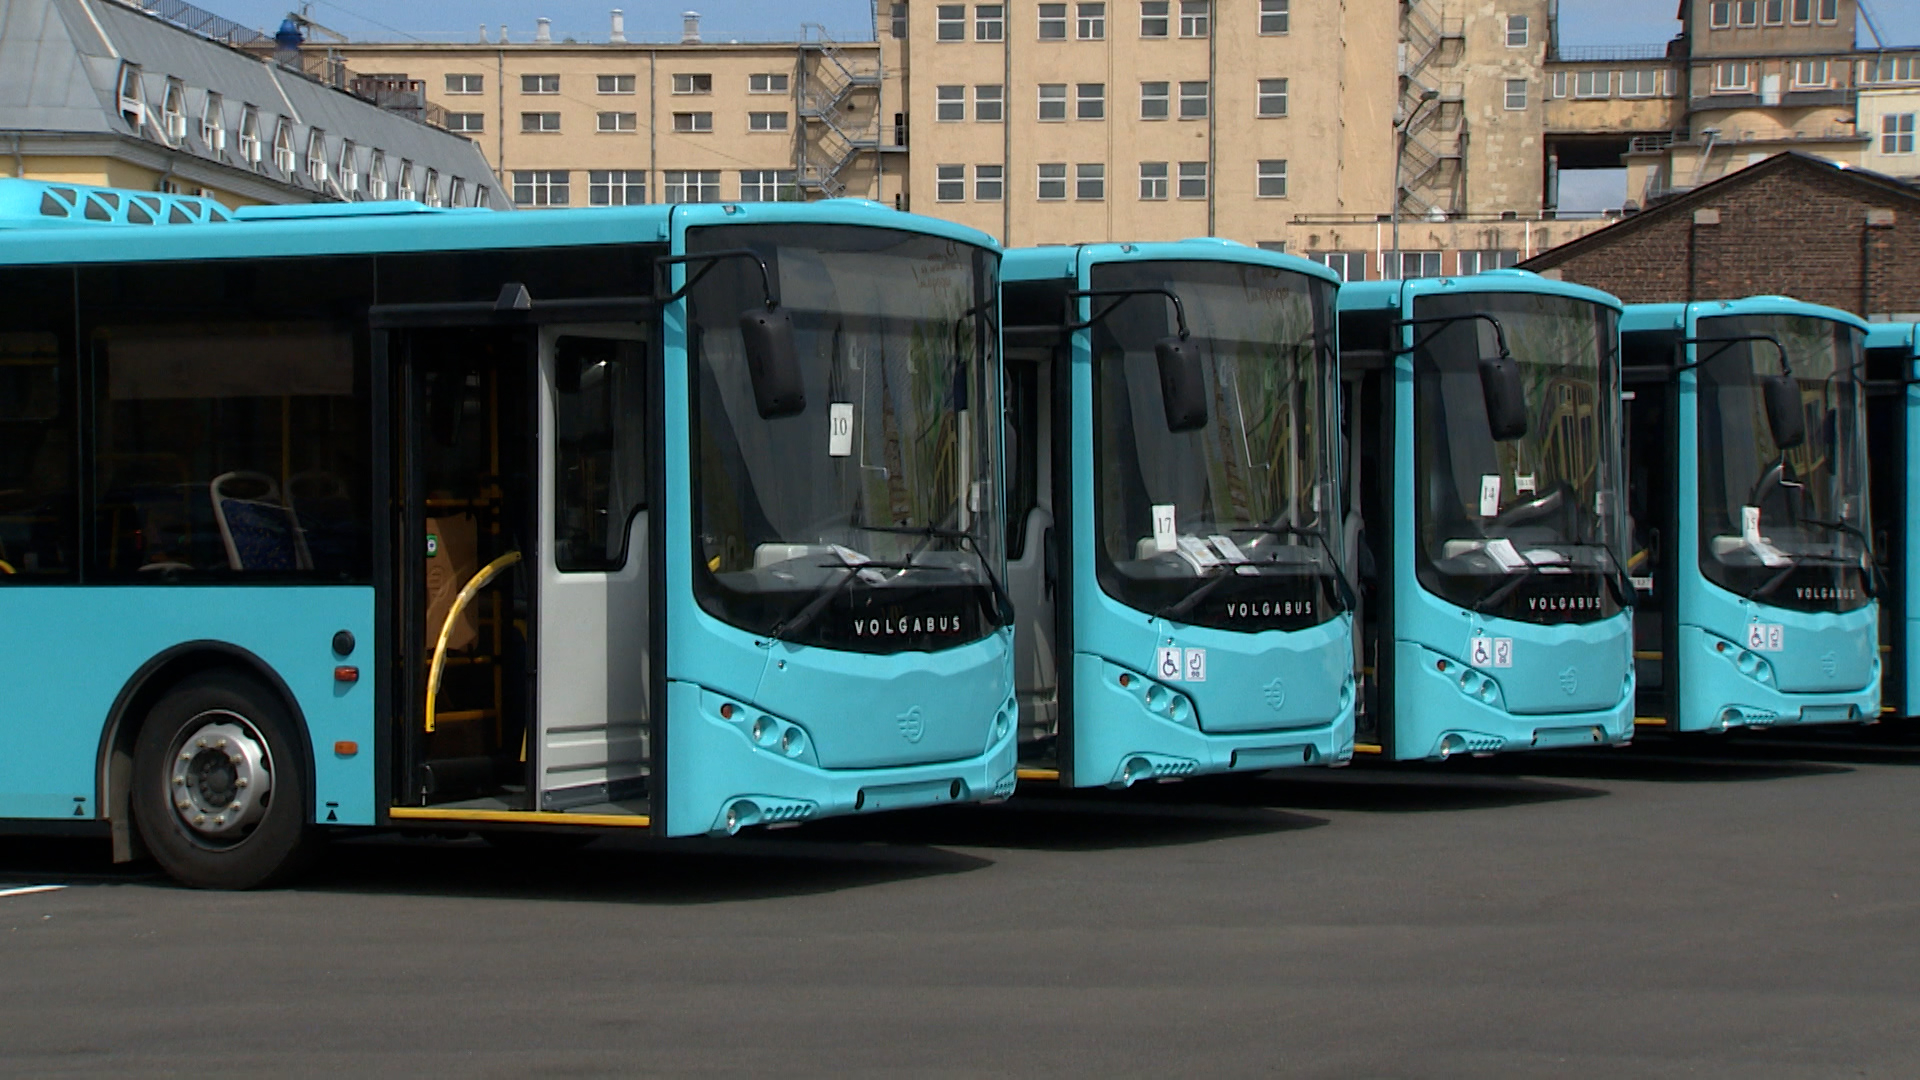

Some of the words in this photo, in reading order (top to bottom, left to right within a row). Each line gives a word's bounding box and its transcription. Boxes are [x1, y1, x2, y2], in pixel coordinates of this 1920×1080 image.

[833, 417, 848, 436] 10
[1158, 517, 1172, 534] 17
[1227, 601, 1312, 618] VOLGABUS
[1529, 597, 1601, 610] VOLGABUS
[854, 615, 960, 636] VOLGABUS
